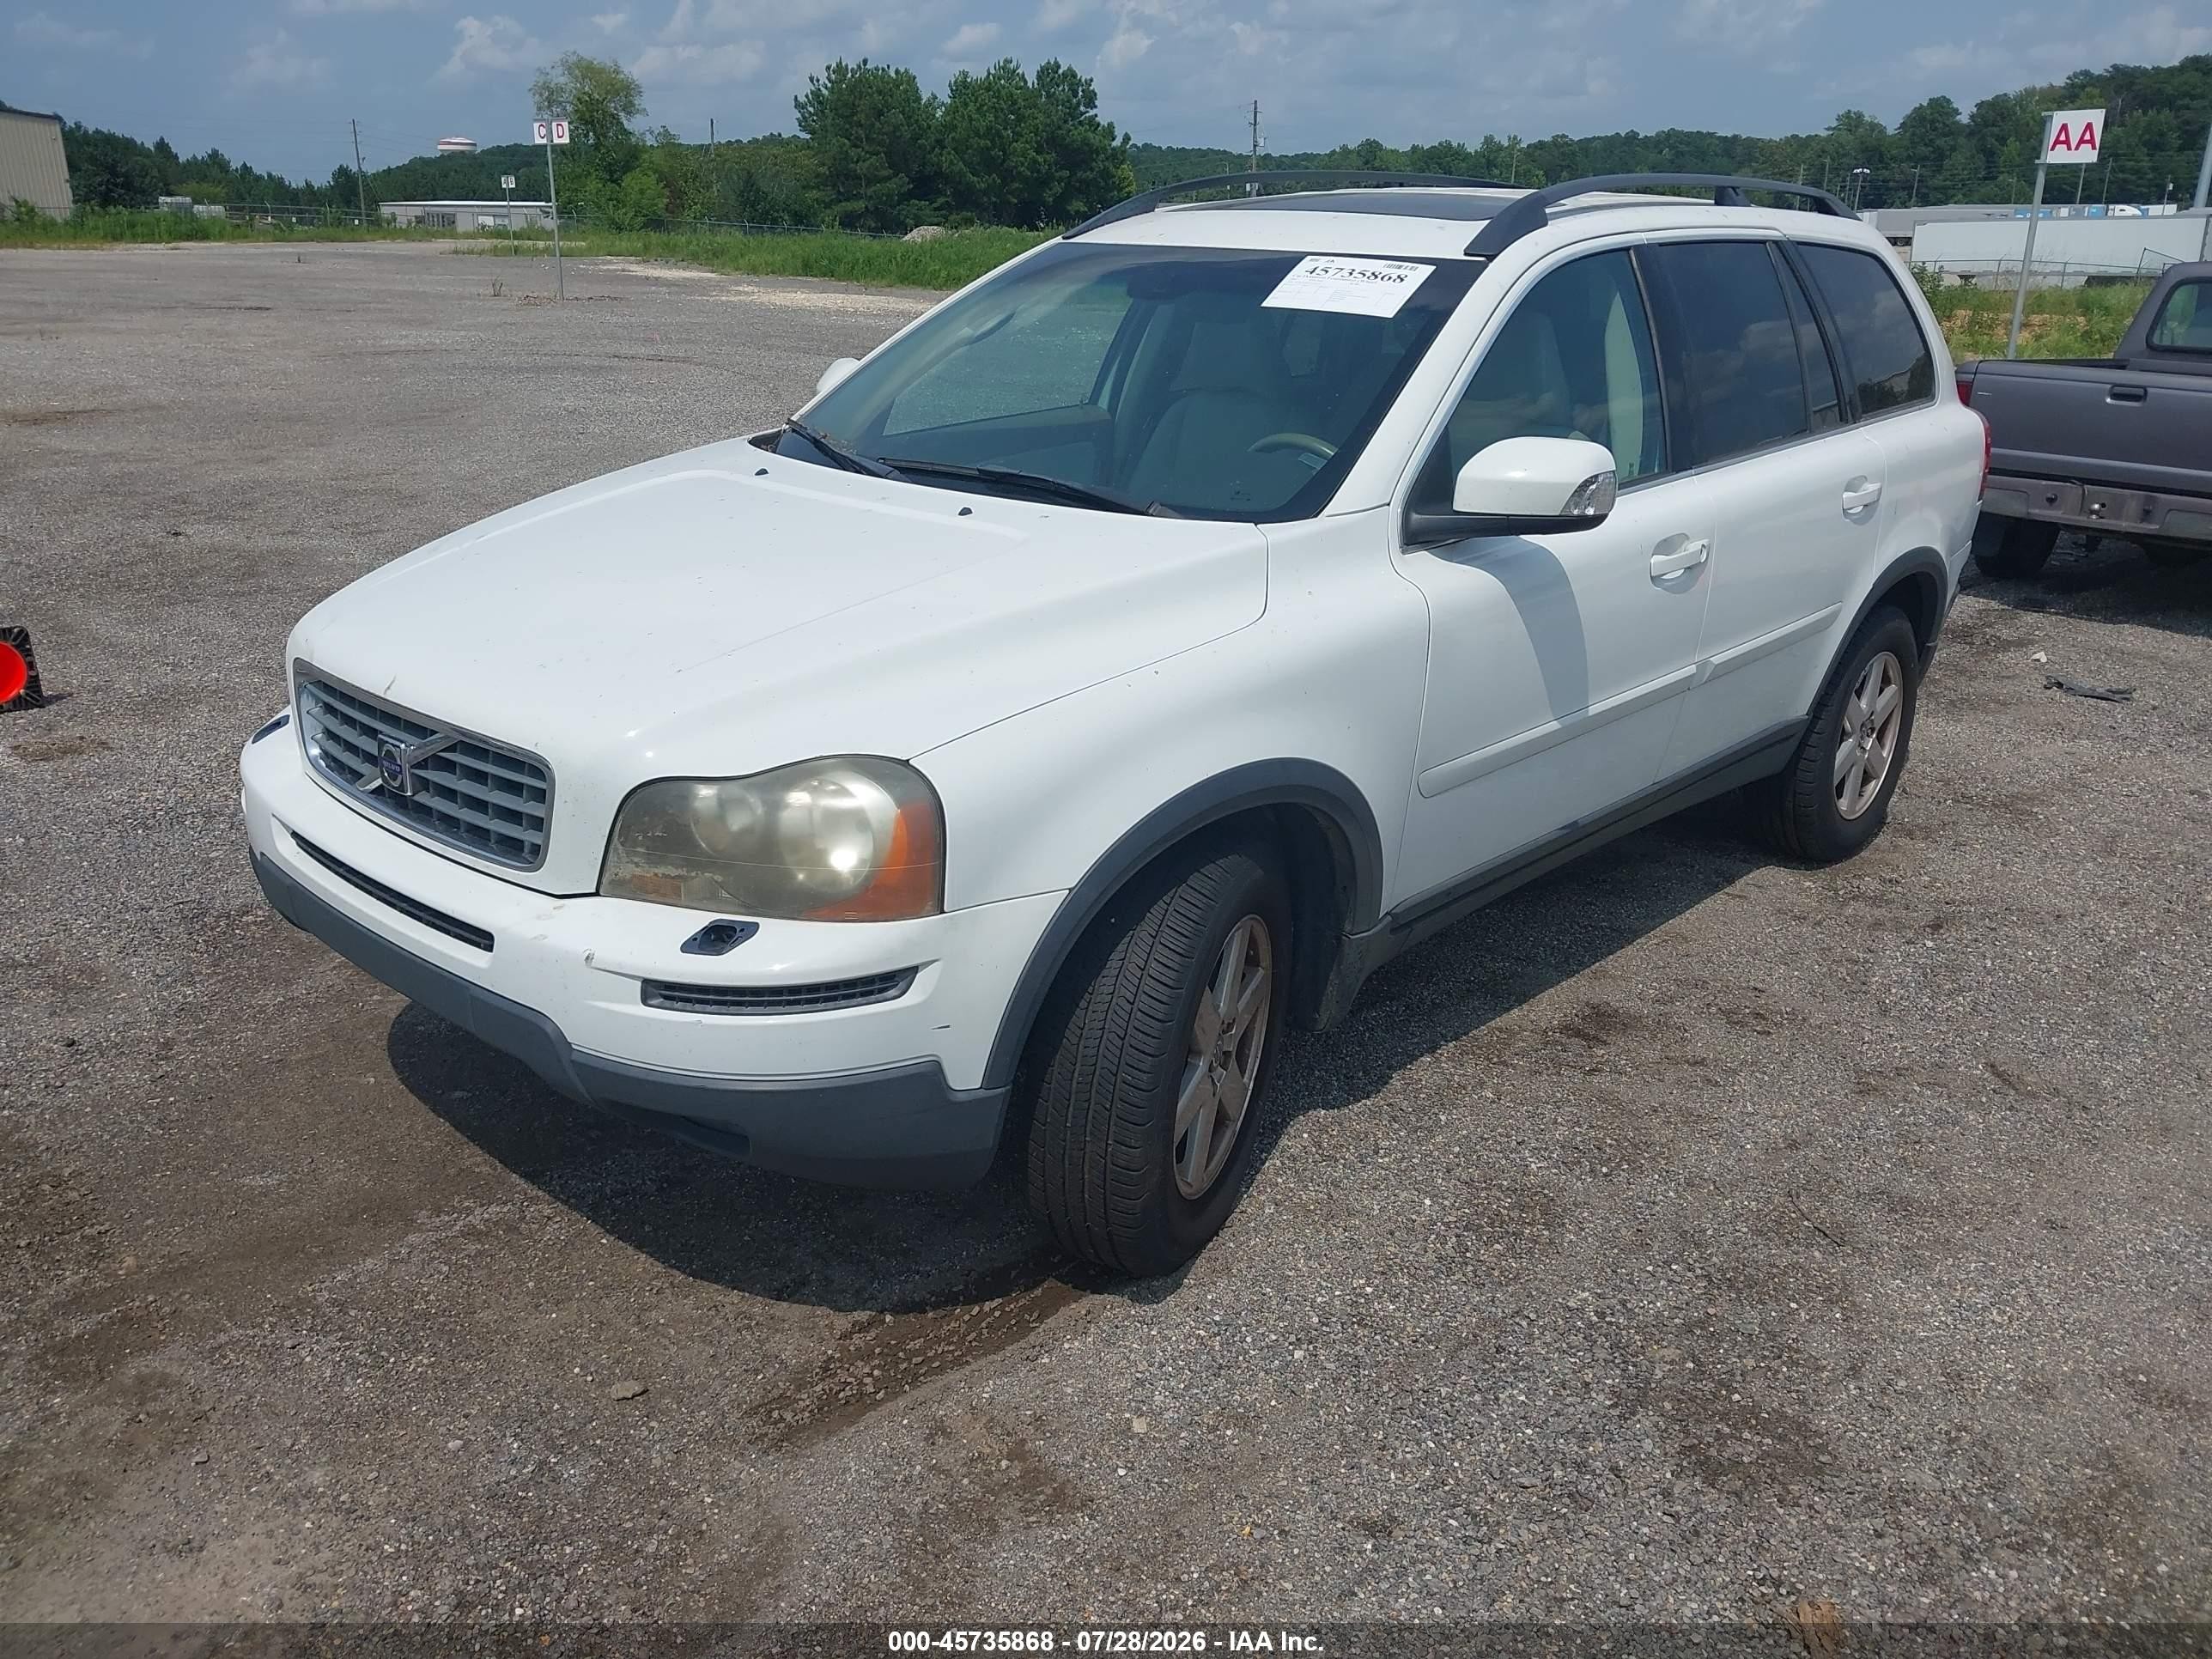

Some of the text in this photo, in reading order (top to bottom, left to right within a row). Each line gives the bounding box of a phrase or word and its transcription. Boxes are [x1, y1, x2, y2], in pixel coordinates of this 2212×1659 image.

[538, 124, 546, 139] C
[556, 123, 564, 138] D
[2050, 122, 2097, 151] AA
[1305, 264, 1408, 284] 45735868
